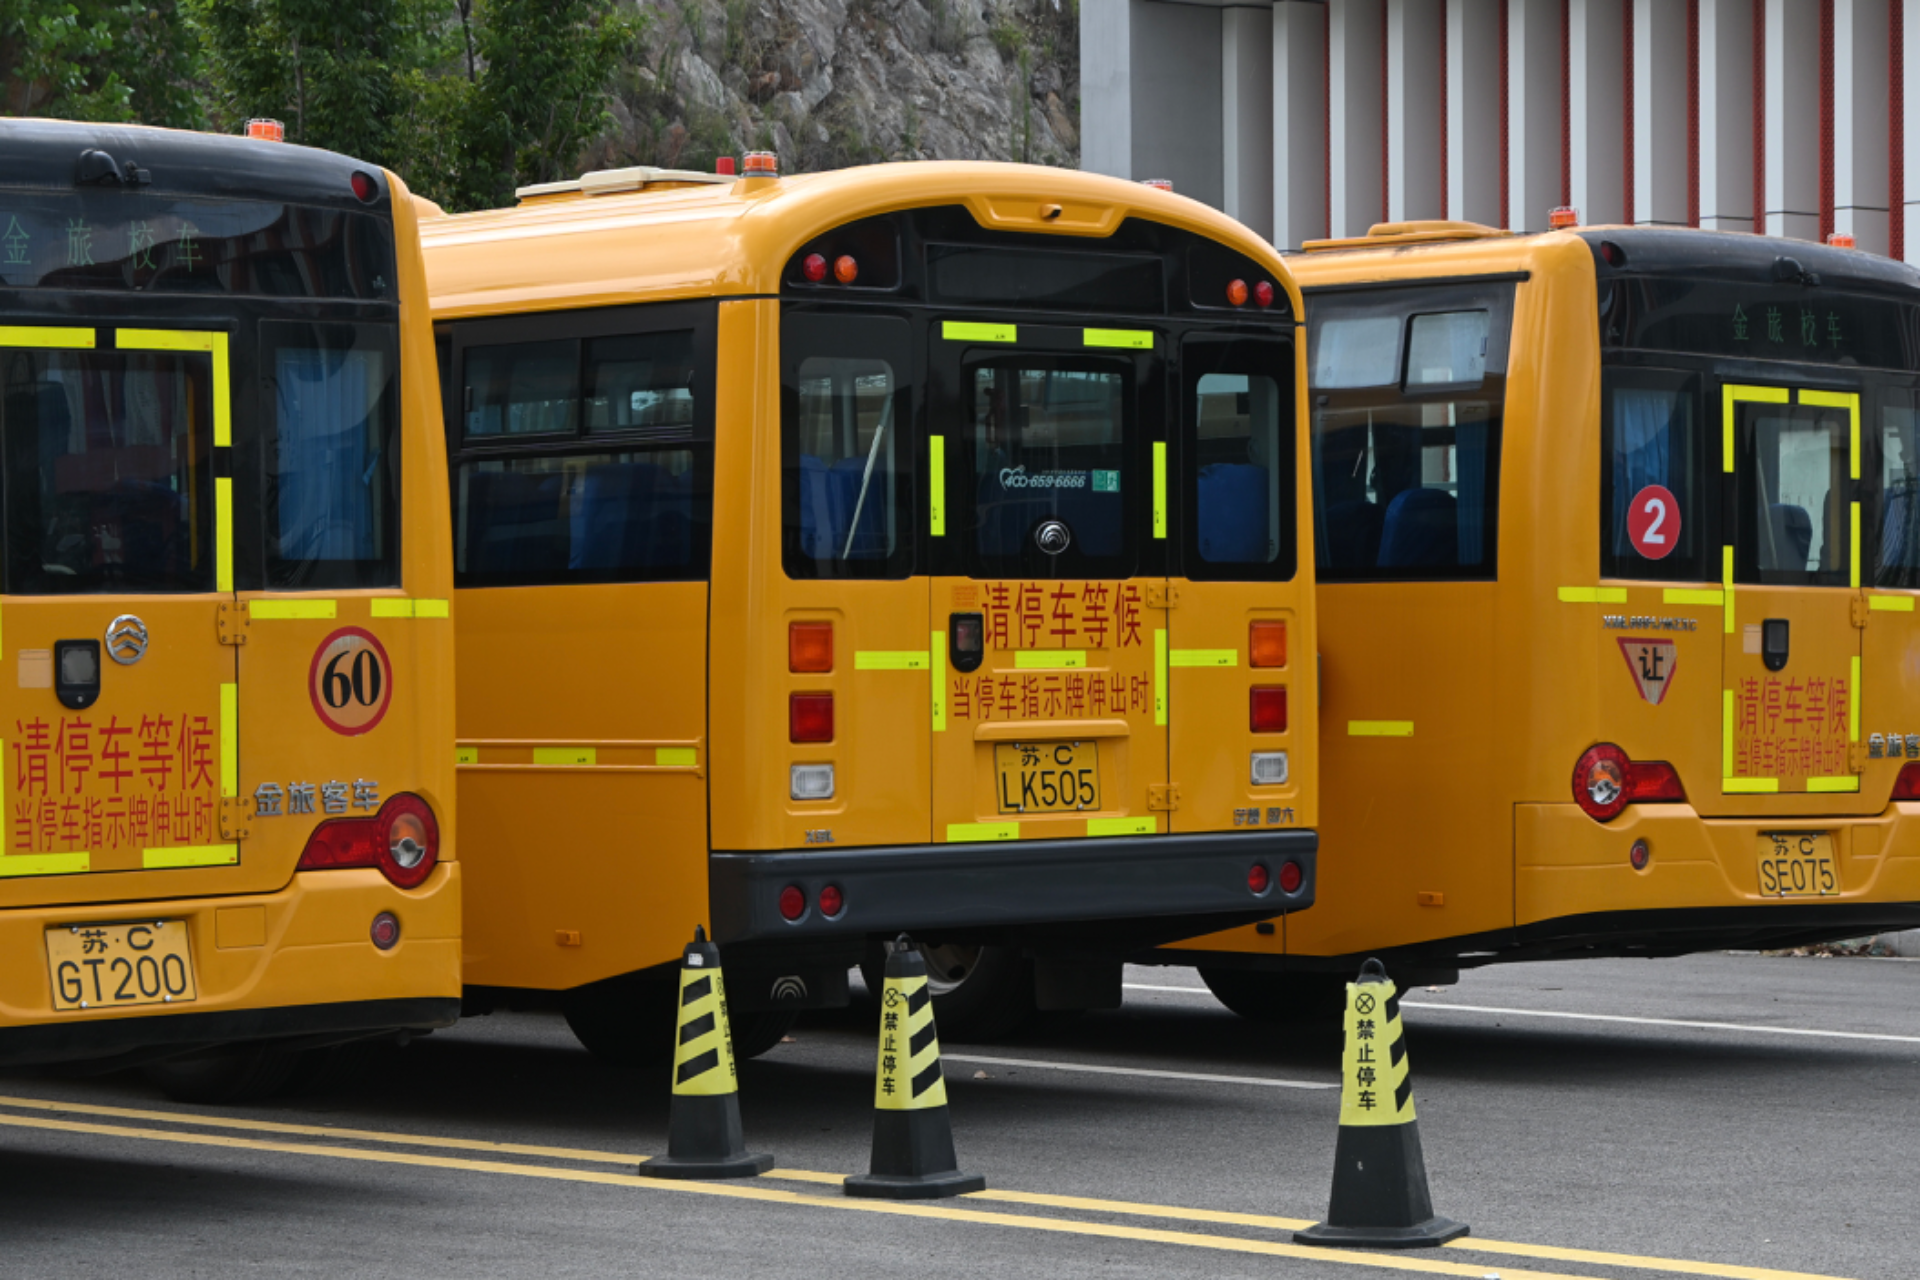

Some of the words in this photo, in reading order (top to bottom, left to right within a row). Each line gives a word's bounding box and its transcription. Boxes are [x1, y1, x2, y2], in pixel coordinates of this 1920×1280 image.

[2, 214, 203, 272] 金旅校车
[1732, 303, 1843, 348] 金旅校车
[1642, 498, 1666, 544] 2
[982, 582, 1142, 649] 请停车等候
[322, 648, 381, 708] 60
[1638, 646, 1665, 681] 让
[953, 671, 1149, 720] 当停车指示牌伸出时
[1738, 676, 1847, 736] 请停车等候
[12, 712, 215, 798] 请停车等候
[1737, 735, 1847, 778] 当停车指示牌伸出时
[254, 778, 380, 816] 金旅客车
[1002, 769, 1095, 808] LK505
[14, 791, 214, 852] 当停车指示牌伸出时
[1761, 858, 1835, 892] SE075
[58, 953, 187, 1004] GT200
[882, 1011, 898, 1096] 禁止停车
[1356, 1019, 1377, 1111] 禁止停车
